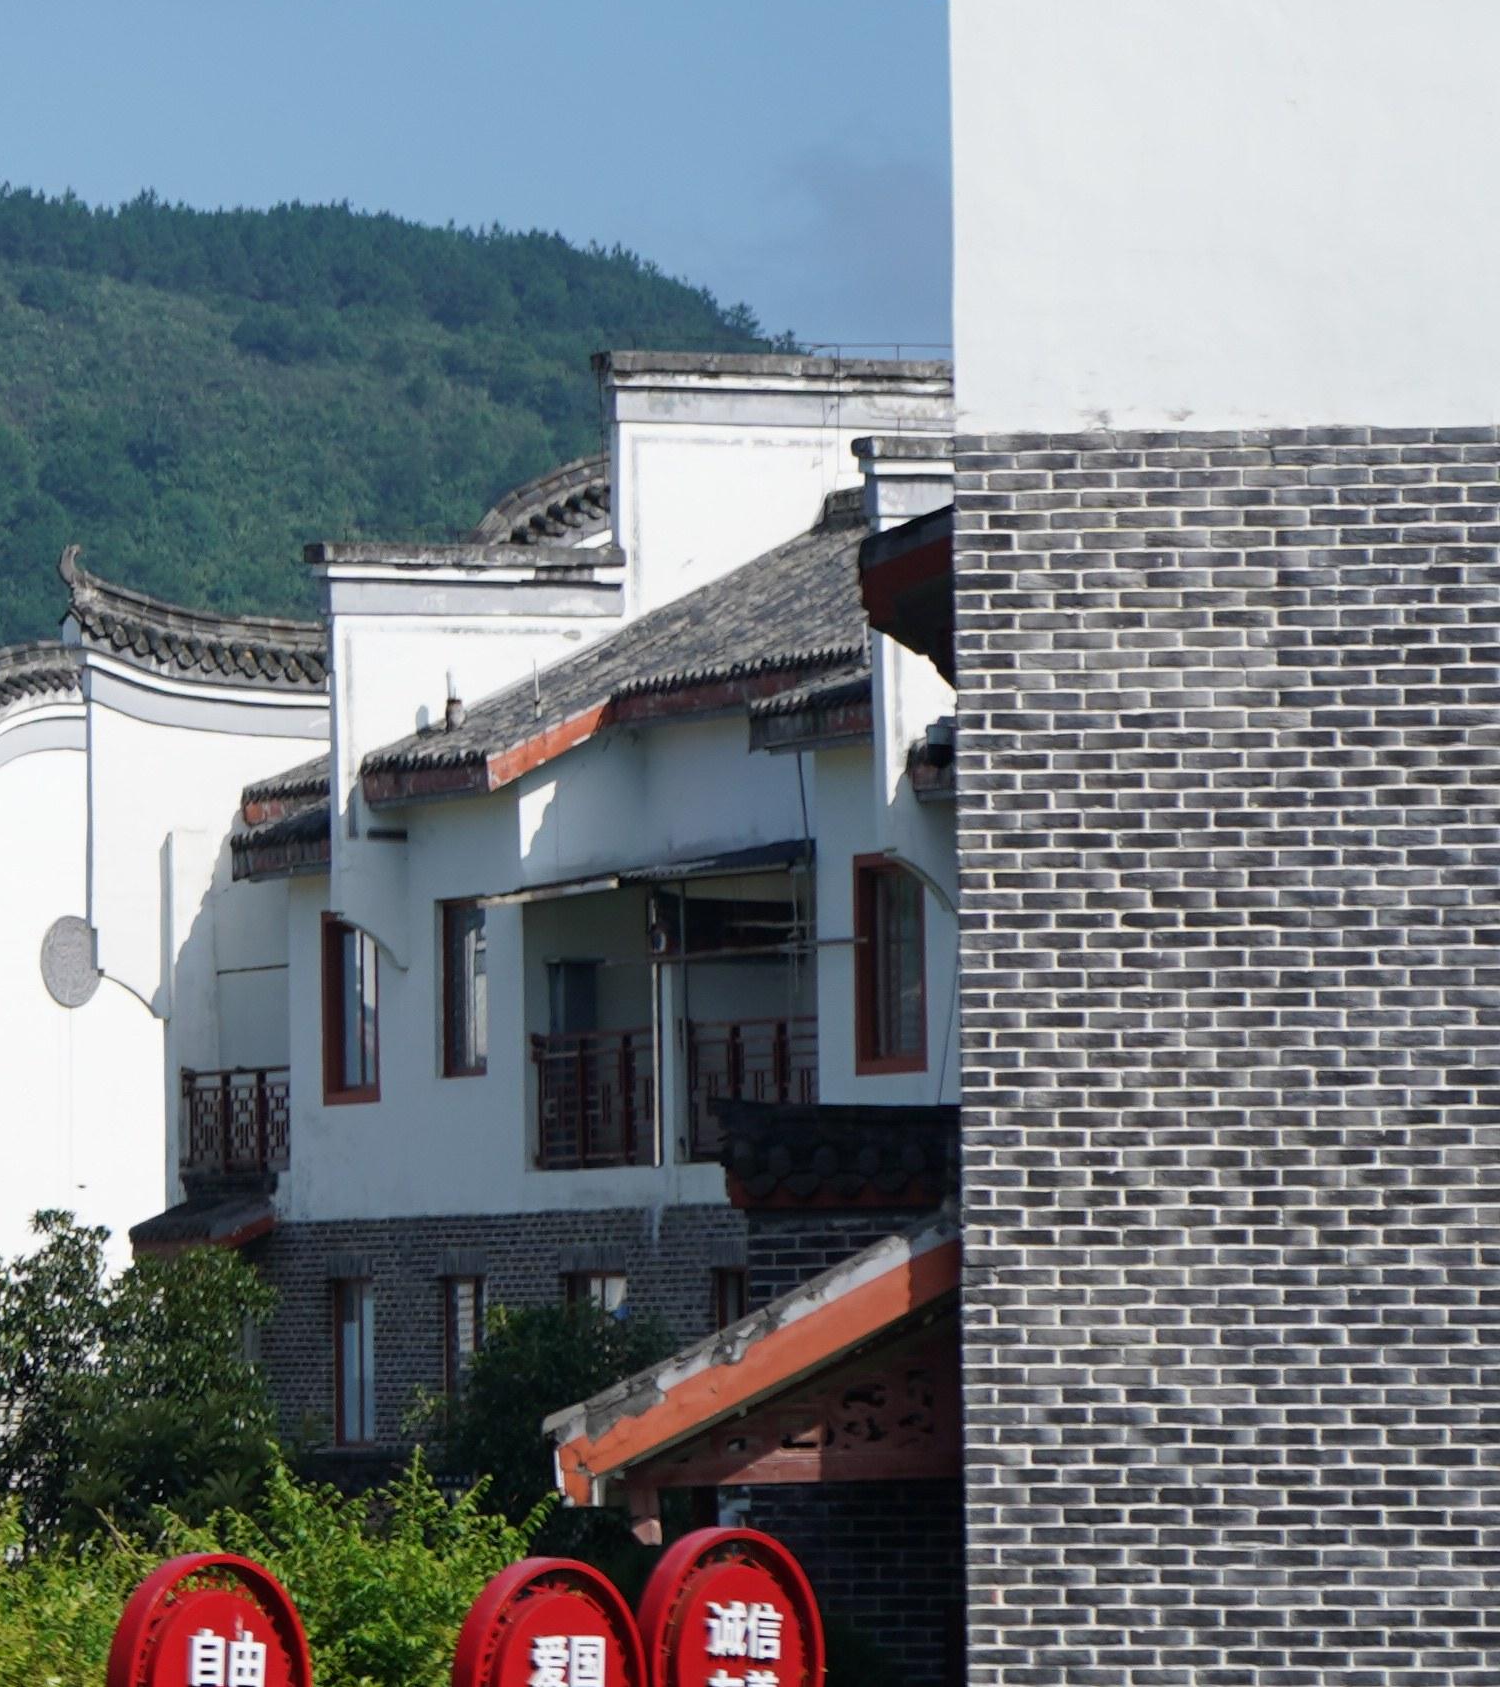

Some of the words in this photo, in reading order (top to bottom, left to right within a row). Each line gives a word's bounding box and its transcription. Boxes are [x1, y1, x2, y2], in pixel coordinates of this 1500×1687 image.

[189, 1626, 268, 1687] 自由
[705, 1600, 784, 1659] 诚信
[528, 1635, 606, 1687] 爱国
